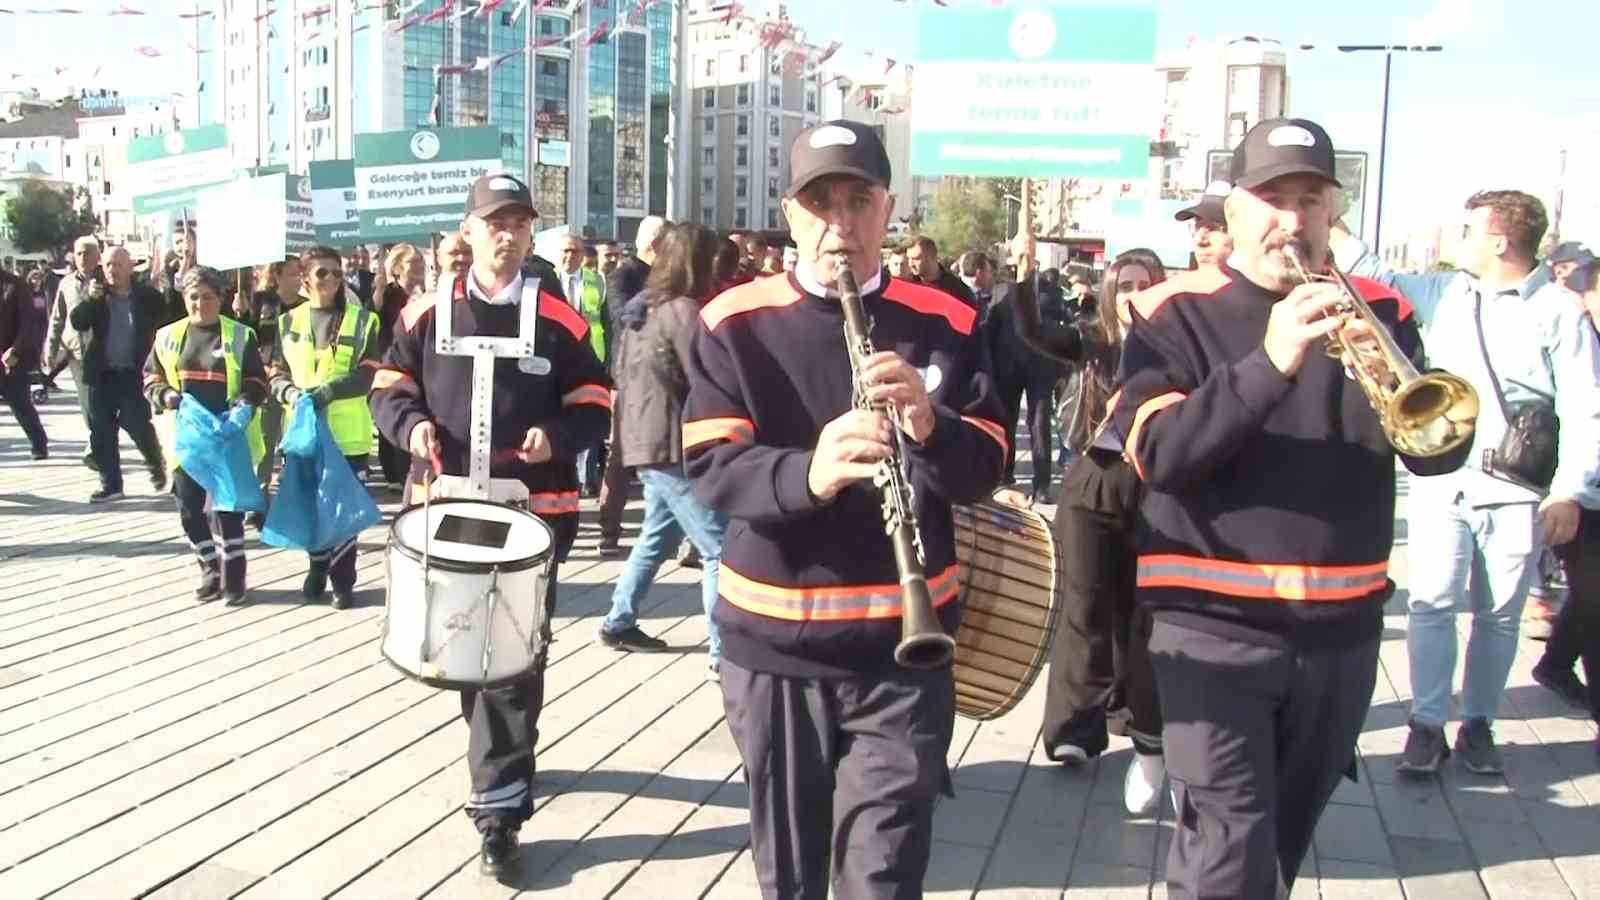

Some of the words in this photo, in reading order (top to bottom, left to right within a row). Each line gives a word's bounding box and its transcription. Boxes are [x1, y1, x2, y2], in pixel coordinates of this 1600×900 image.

[370, 172, 427, 184] Geleceğe
[431, 168, 466, 179] temiz
[470, 167, 488, 177] bir
[368, 187, 424, 201] Esenyurt
[428, 184, 474, 195] bırakal
